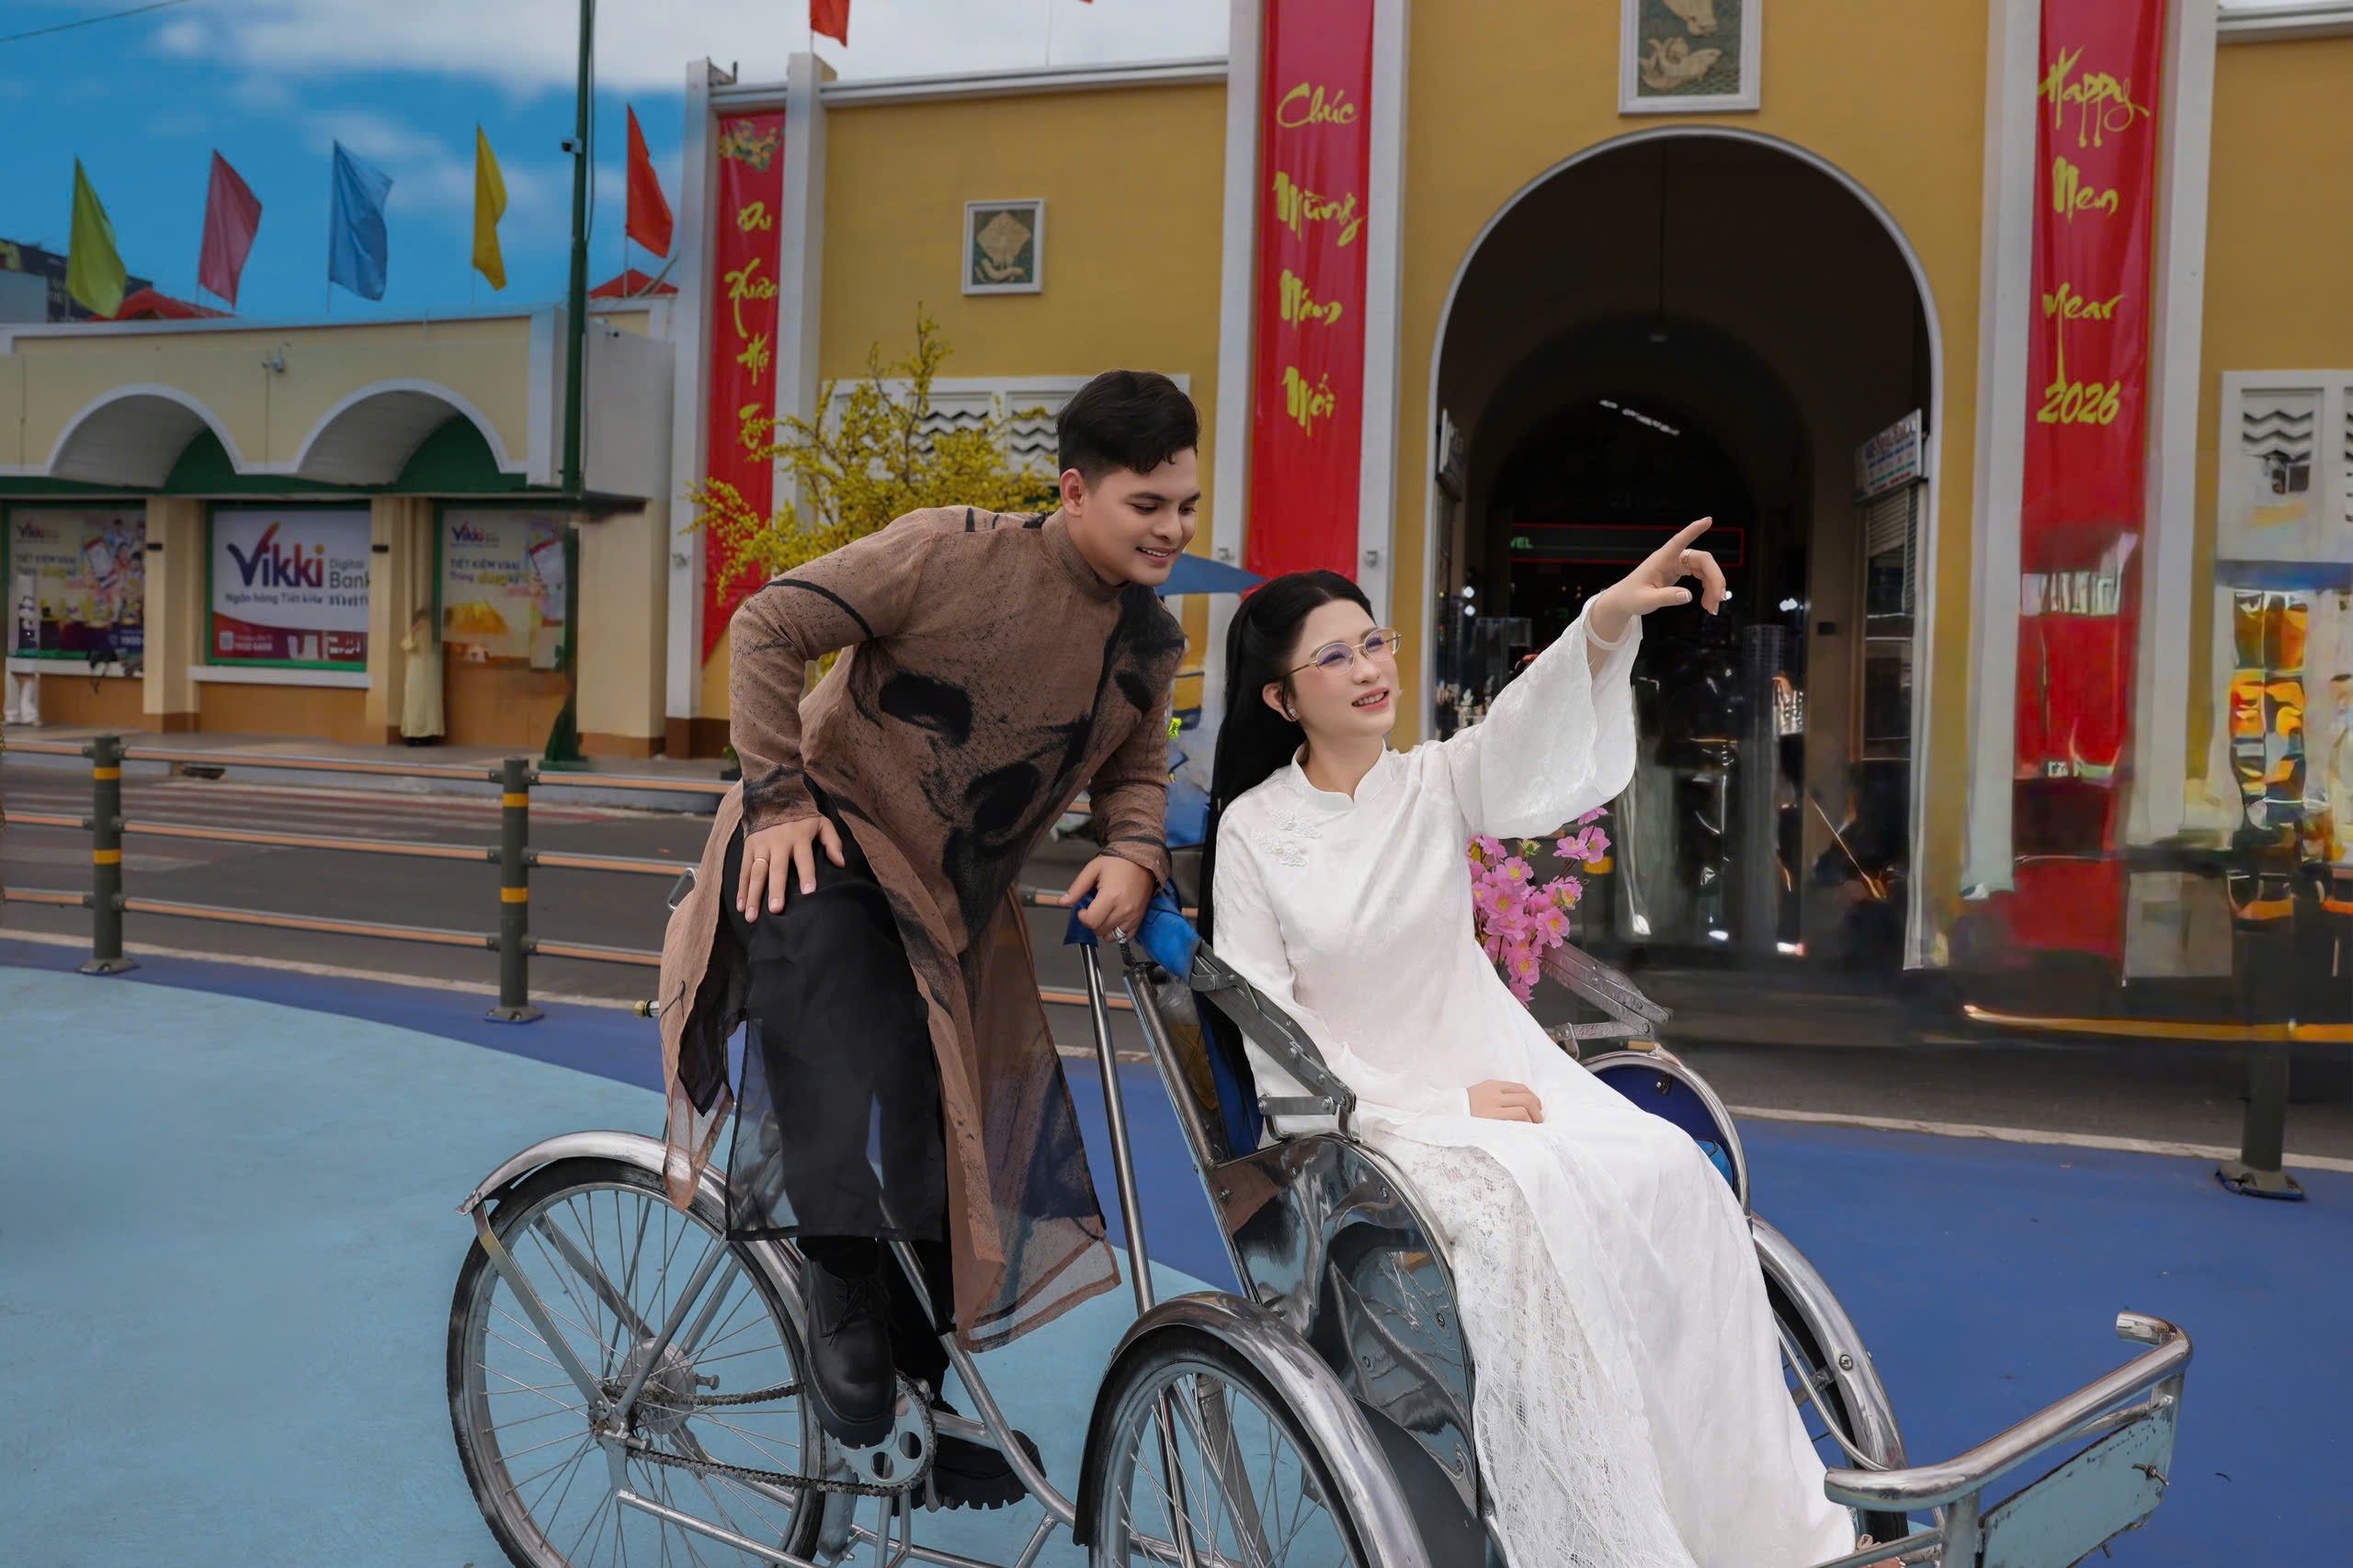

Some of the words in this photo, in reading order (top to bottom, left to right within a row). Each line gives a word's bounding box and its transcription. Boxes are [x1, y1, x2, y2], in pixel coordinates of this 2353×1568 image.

[1276, 82, 1357, 128] Chúc
[2038, 44, 2151, 147] Happy
[2041, 282, 2127, 383] Year
[2036, 380, 2120, 426] 2026
[226, 521, 324, 587] Vikki
